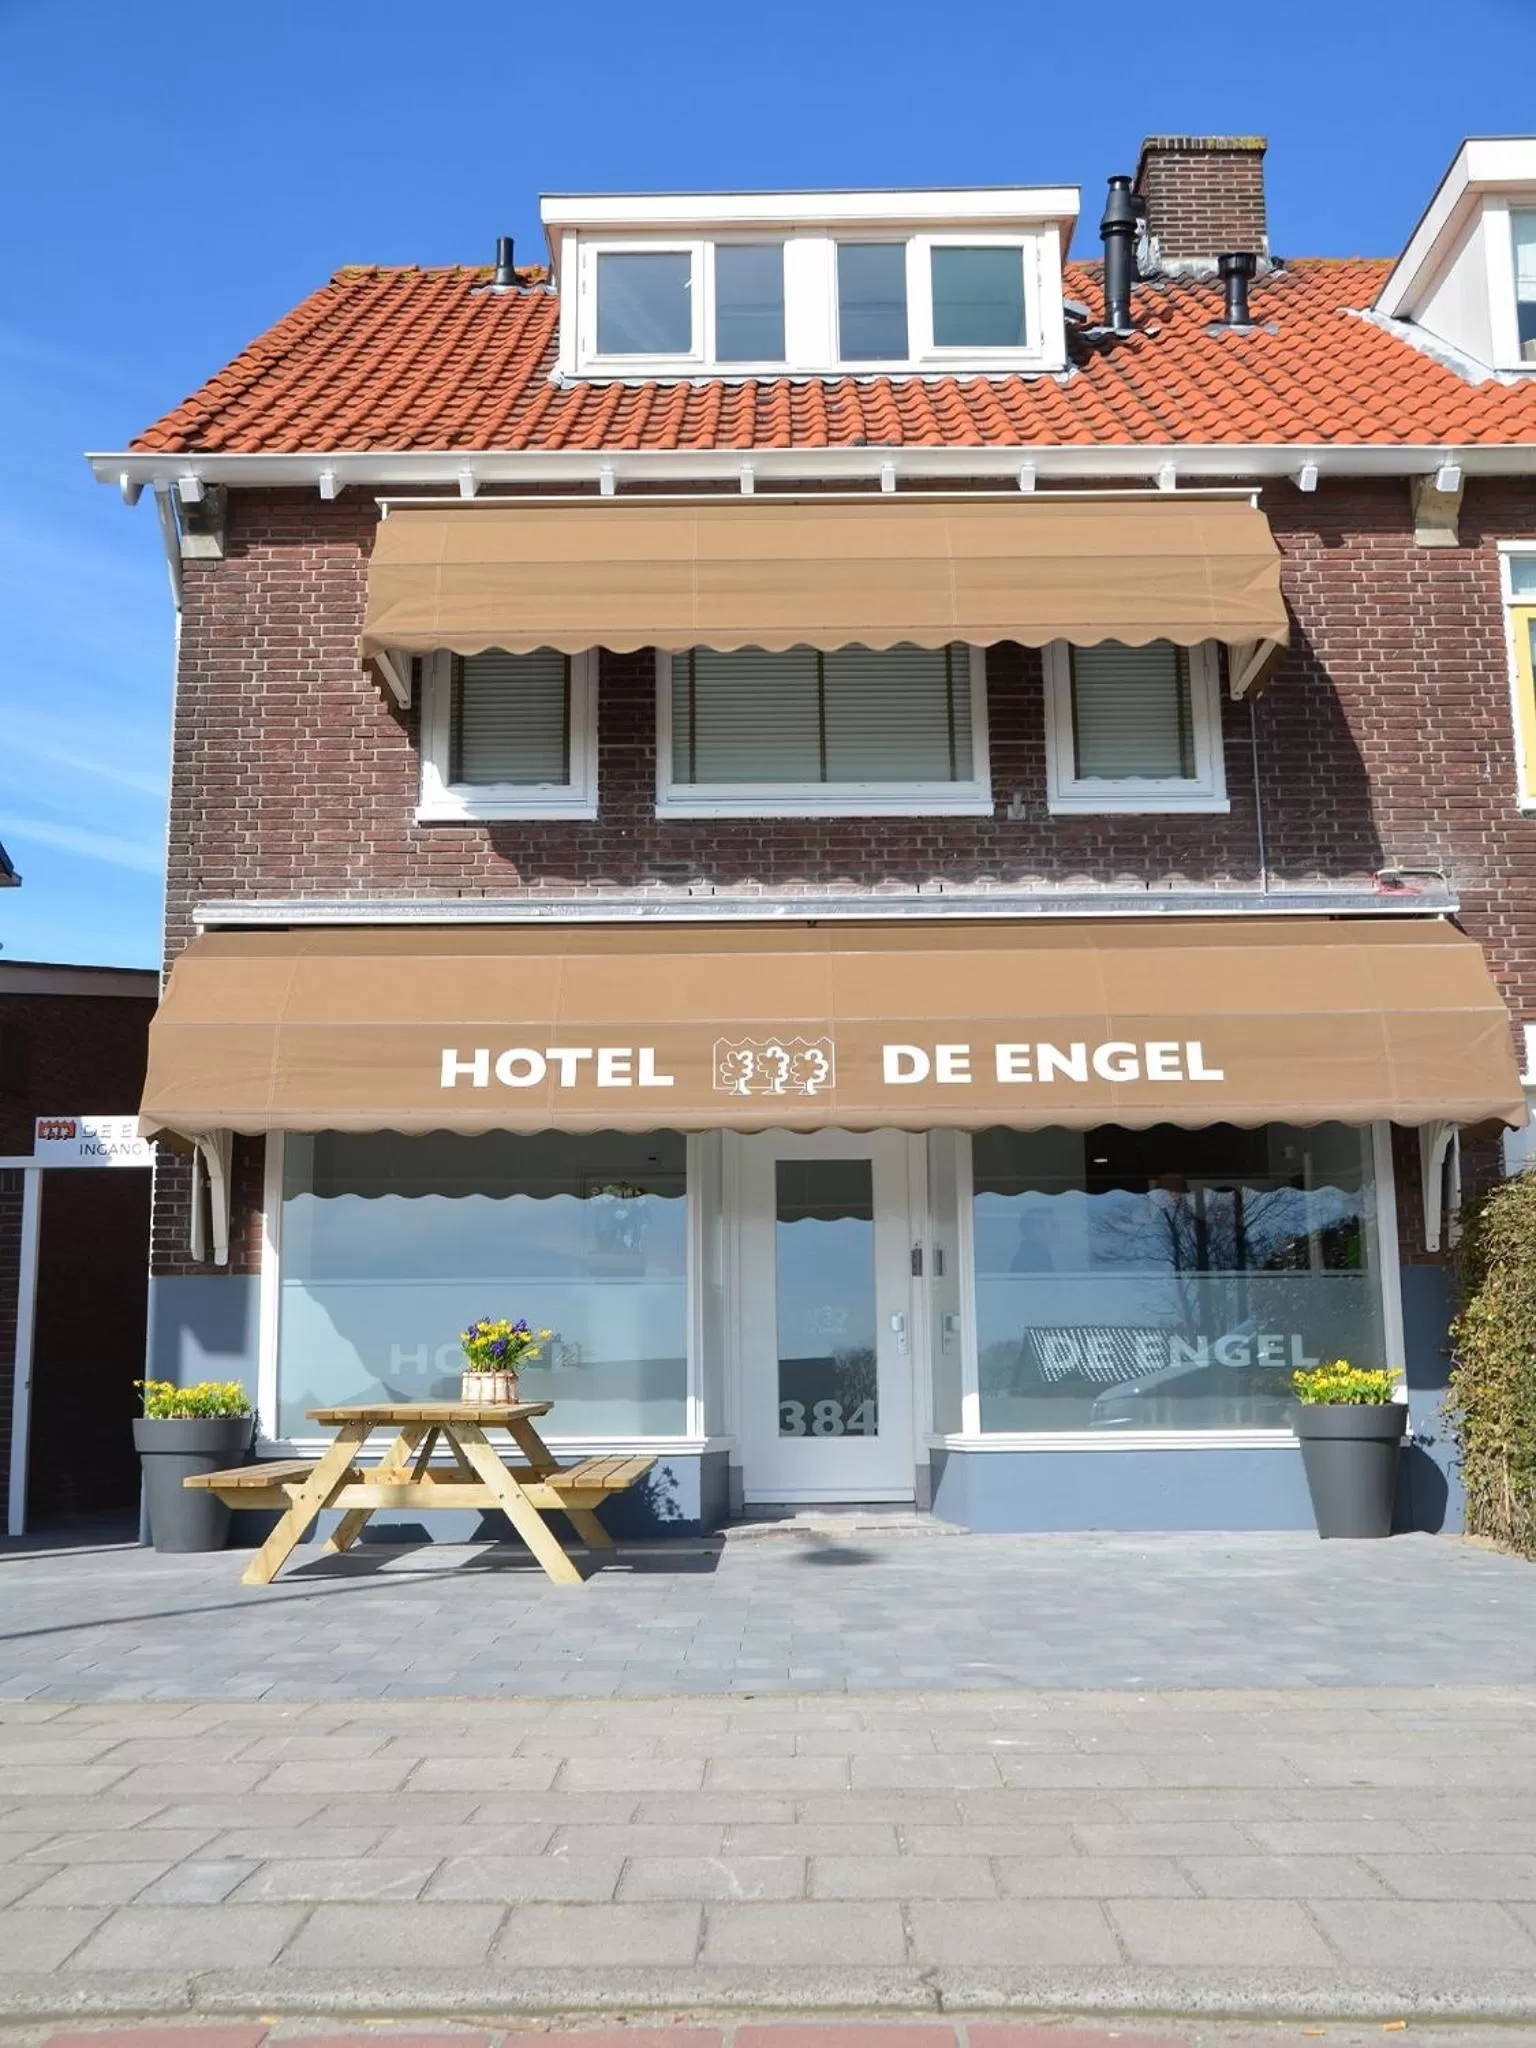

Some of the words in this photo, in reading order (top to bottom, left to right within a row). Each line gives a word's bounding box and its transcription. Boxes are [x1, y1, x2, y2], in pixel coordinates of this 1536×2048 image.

[441, 1048, 674, 1087] HOTEL
[883, 1044, 972, 1084] DE
[995, 1041, 1224, 1082] ENGEL
[81, 1124, 112, 1138] DE
[79, 1143, 143, 1156] INGANG
[1044, 1334, 1117, 1369] DE
[1134, 1334, 1320, 1368] ENGEL
[779, 1399, 878, 1436] 384
